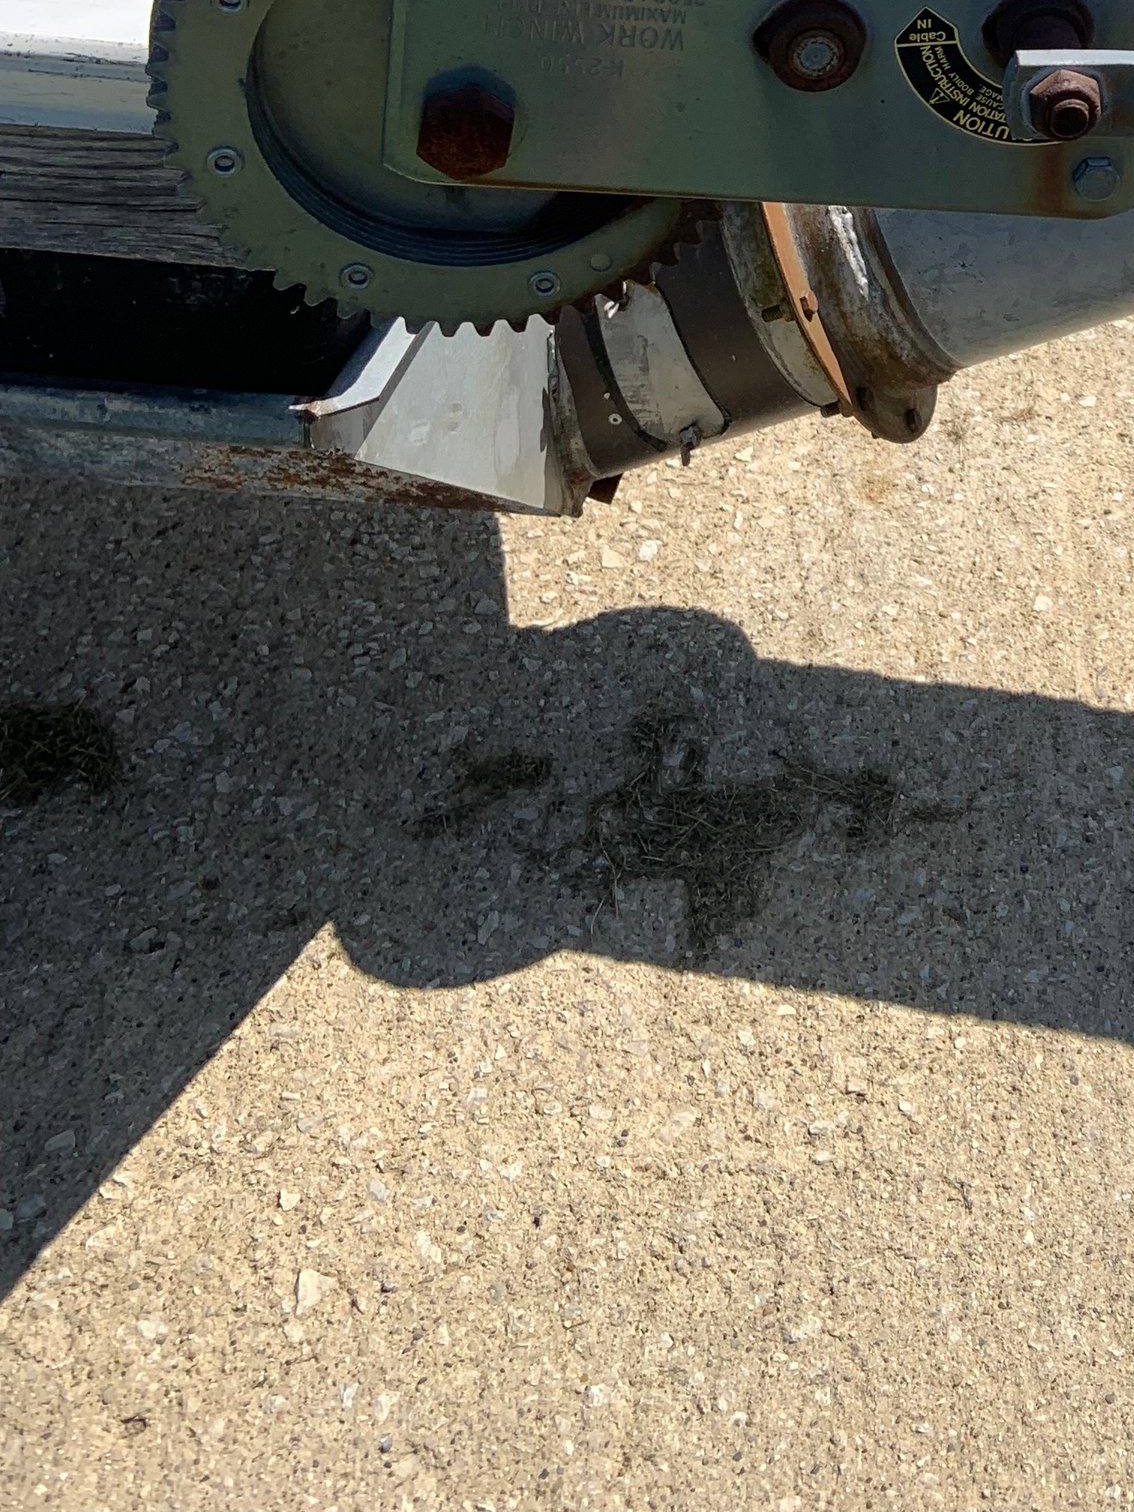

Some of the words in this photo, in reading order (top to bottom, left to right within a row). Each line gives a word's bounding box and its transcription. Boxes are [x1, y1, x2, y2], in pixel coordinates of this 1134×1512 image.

[483, 14, 585, 45] WINCH
[916, 18, 932, 29] IN
[597, 23, 685, 52] WORK
[908, 31, 947, 43] Cable
[934, 46, 951, 70] HARM
[919, 44, 971, 106] INSTRUCTION
[947, 71, 975, 95] BODILY
[968, 100, 1007, 123] TATION
[974, 93, 1005, 110] CAUSE
[952, 109, 1011, 140] UTION
